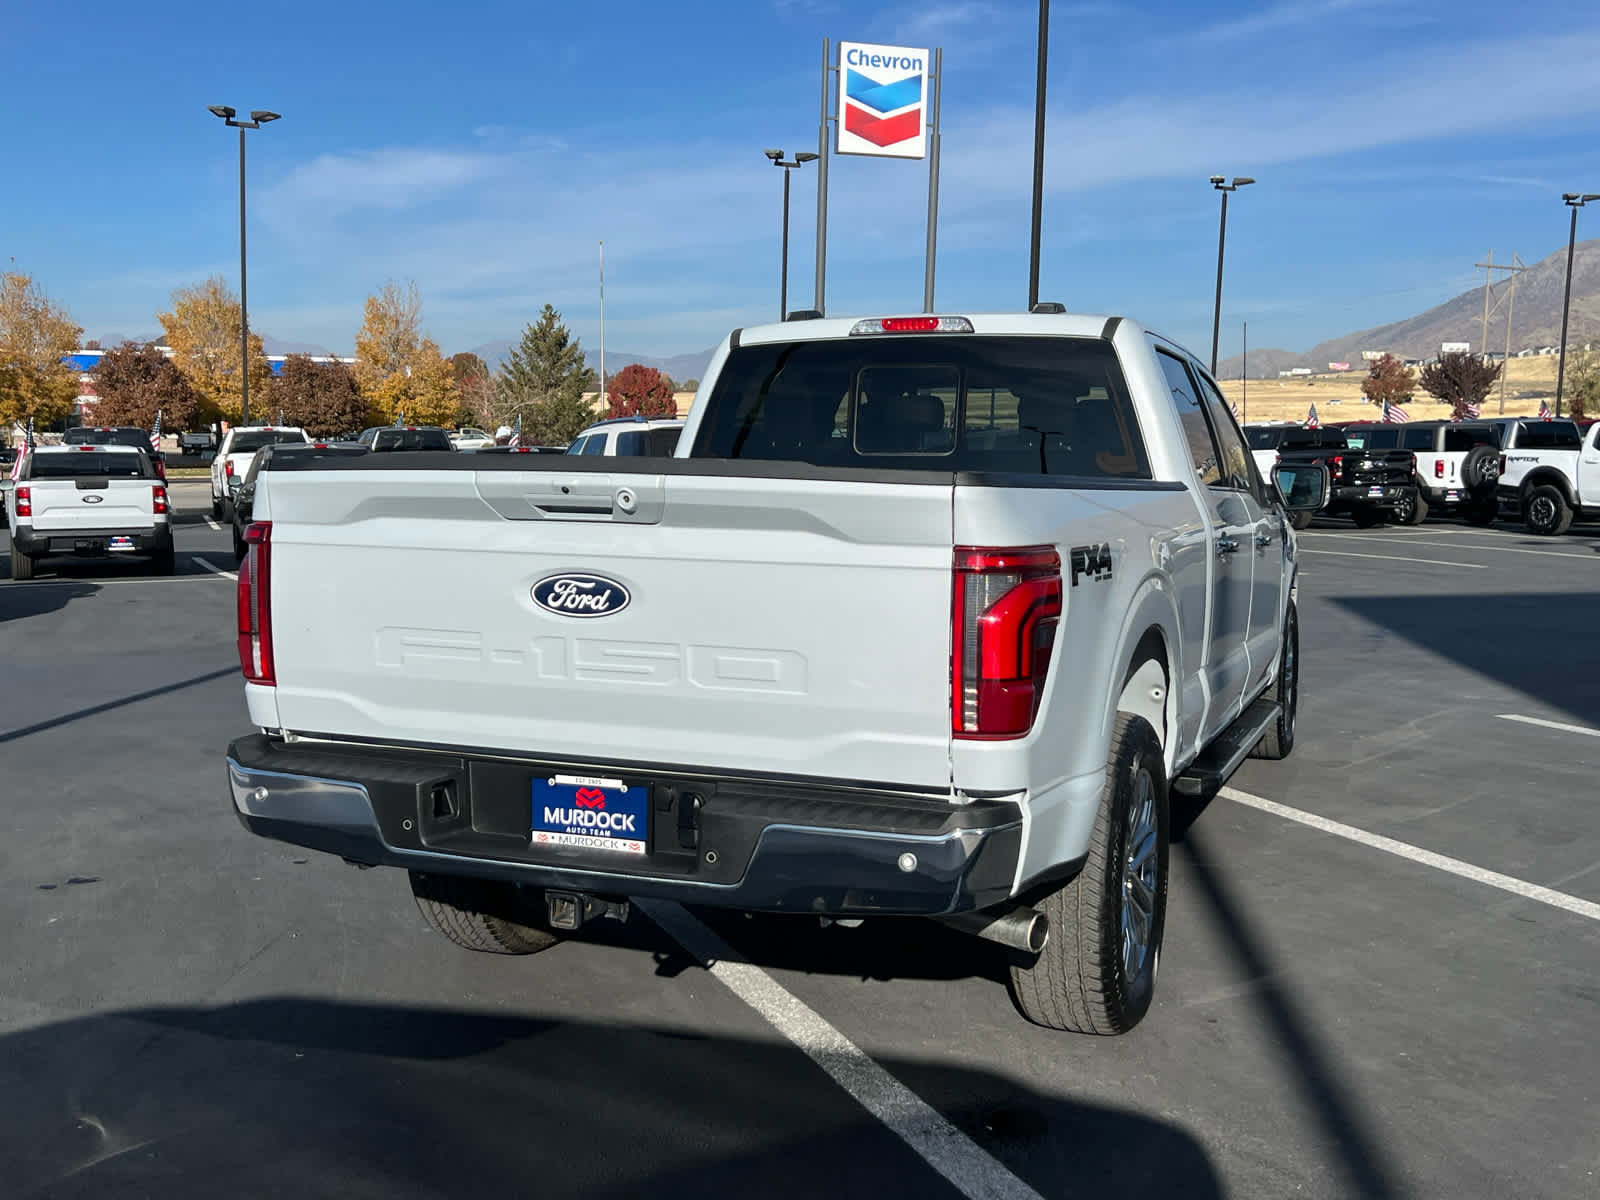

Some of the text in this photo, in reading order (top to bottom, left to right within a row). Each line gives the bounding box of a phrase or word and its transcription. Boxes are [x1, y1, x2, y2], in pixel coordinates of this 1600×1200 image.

[847, 48, 922, 71] Chevron
[1508, 456, 1540, 464] RAPTOR
[1071, 542, 1112, 587] FX4
[547, 579, 611, 610] Ford
[375, 625, 809, 695] F-150
[544, 806, 636, 832] MURDOCK
[558, 835, 619, 849] MURDOCK
[566, 826, 611, 837] AUTO TEAM
